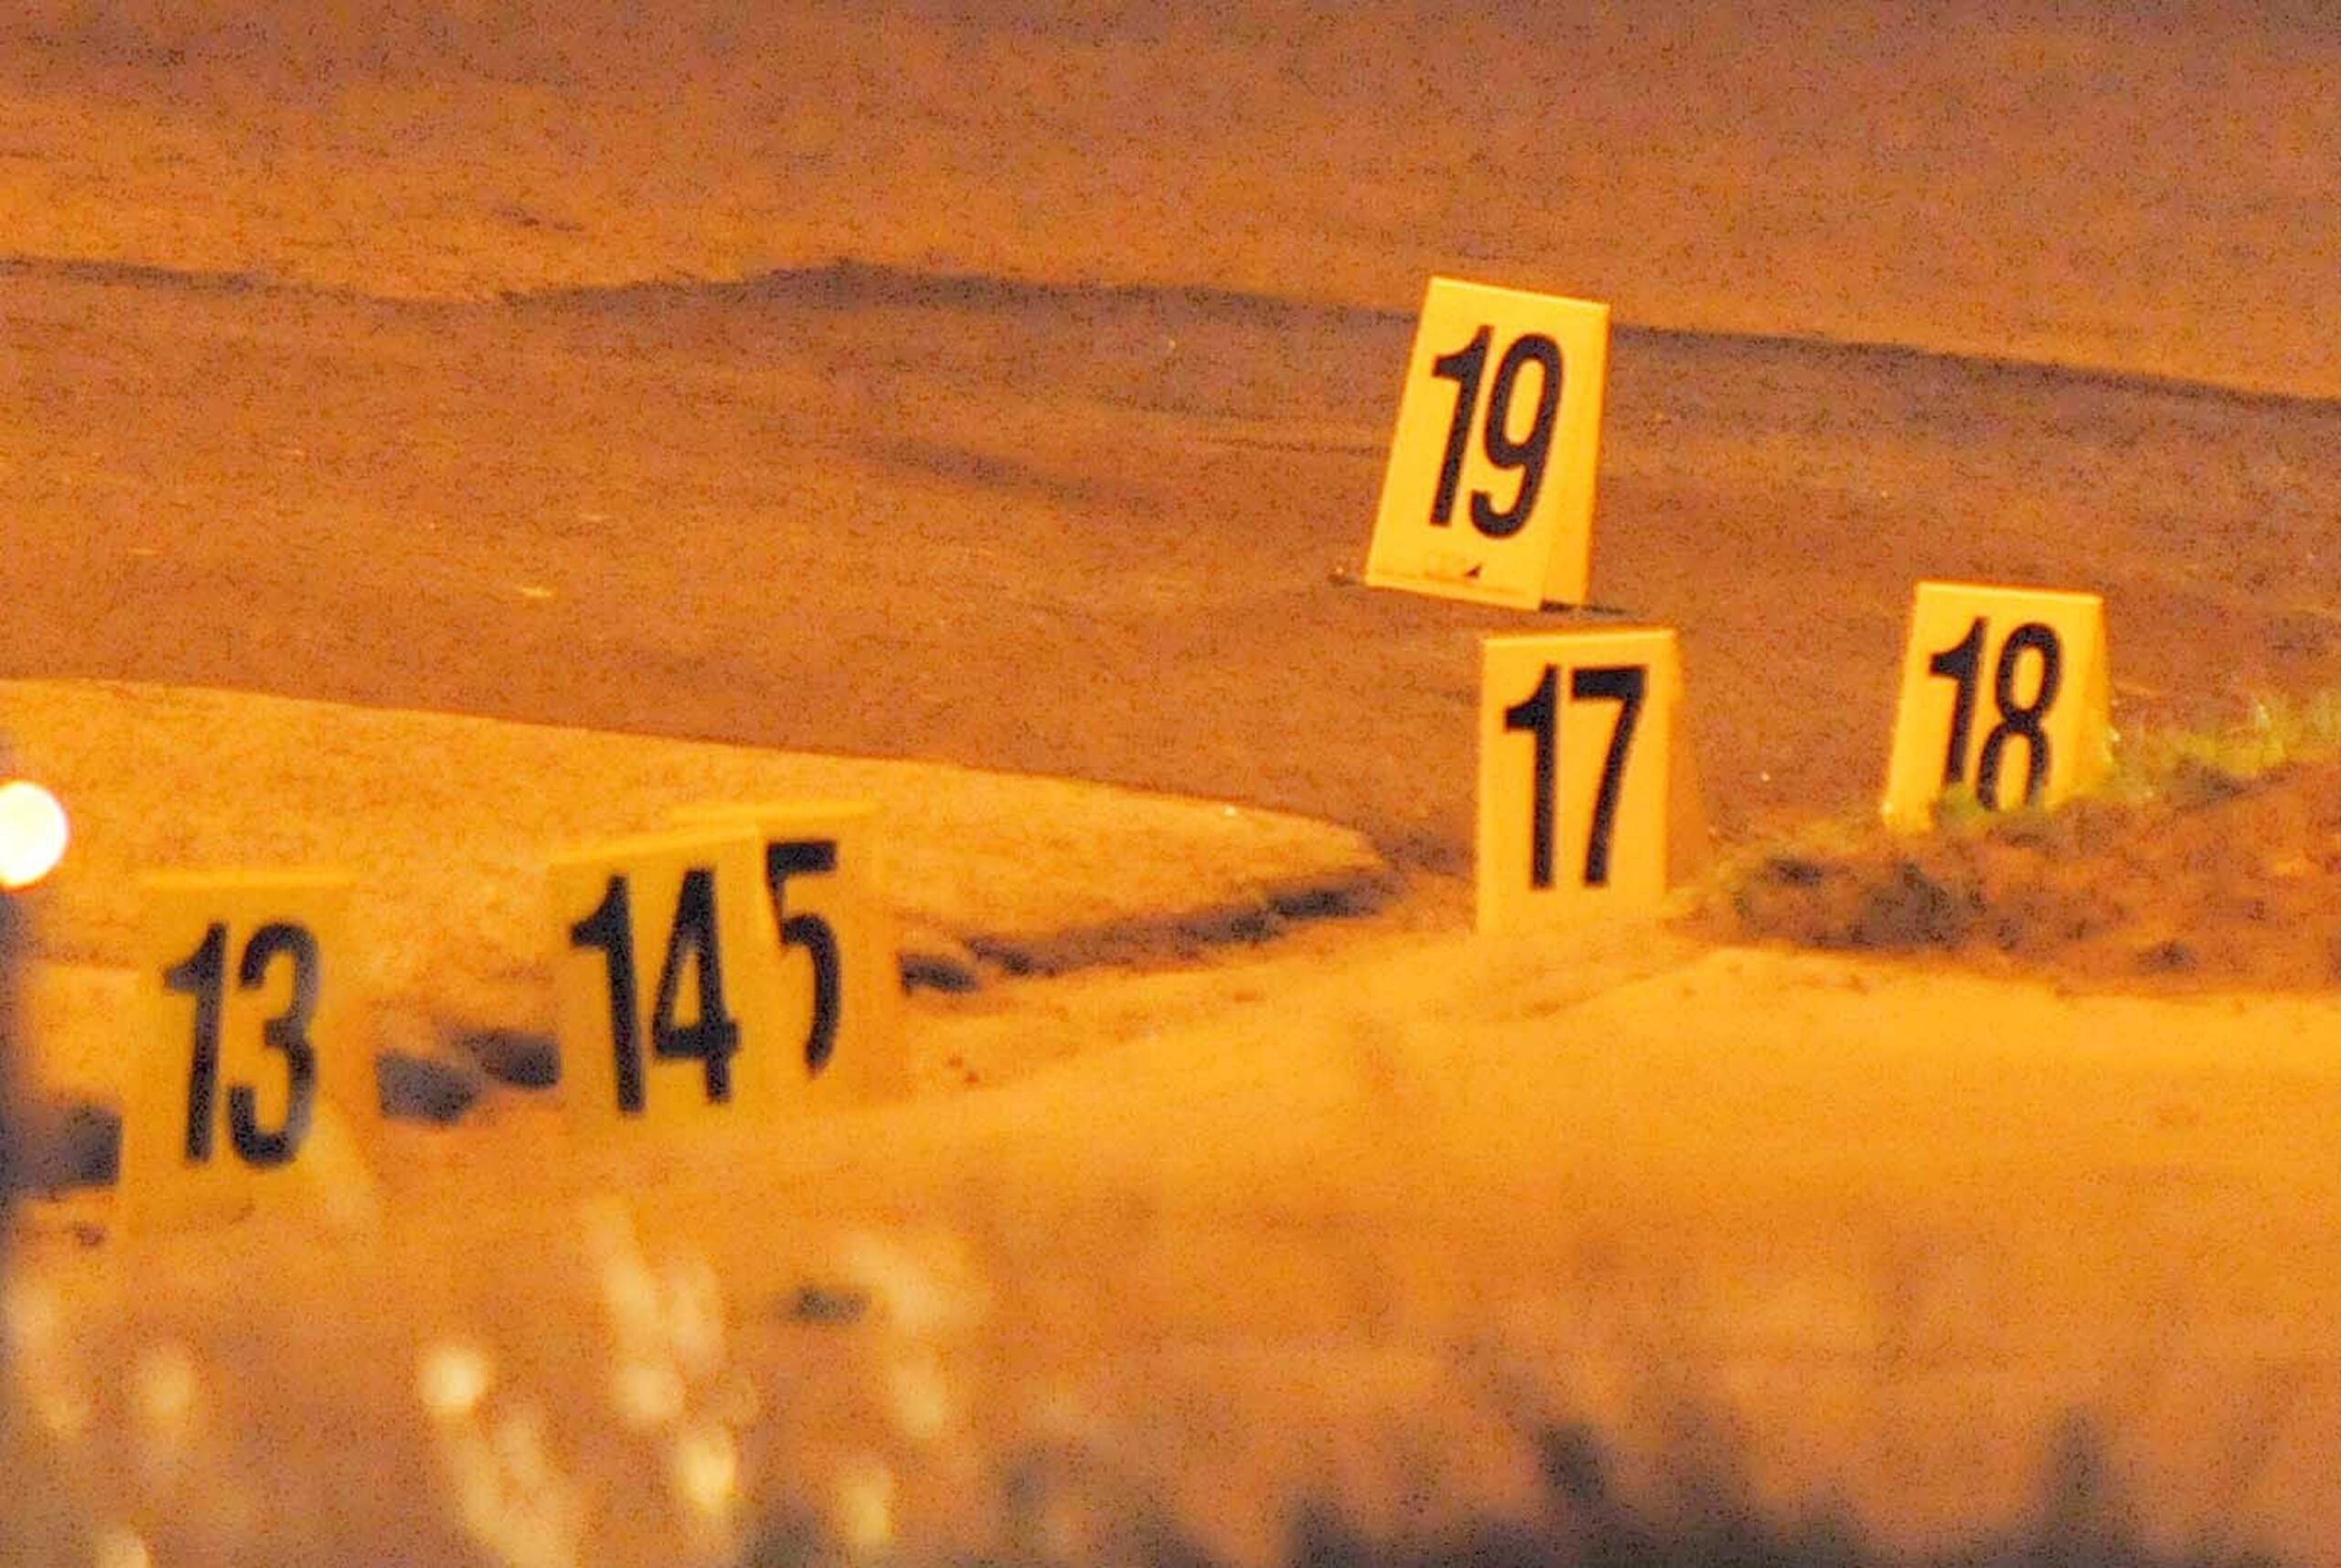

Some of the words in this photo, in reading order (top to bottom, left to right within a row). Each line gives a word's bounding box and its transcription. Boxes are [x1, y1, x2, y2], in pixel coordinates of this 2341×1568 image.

[1429, 325, 1563, 538] 19
[1505, 665, 1646, 888] 17
[1929, 618, 2060, 811] 18
[165, 922, 317, 1169] 13
[570, 869, 740, 1114] 14
